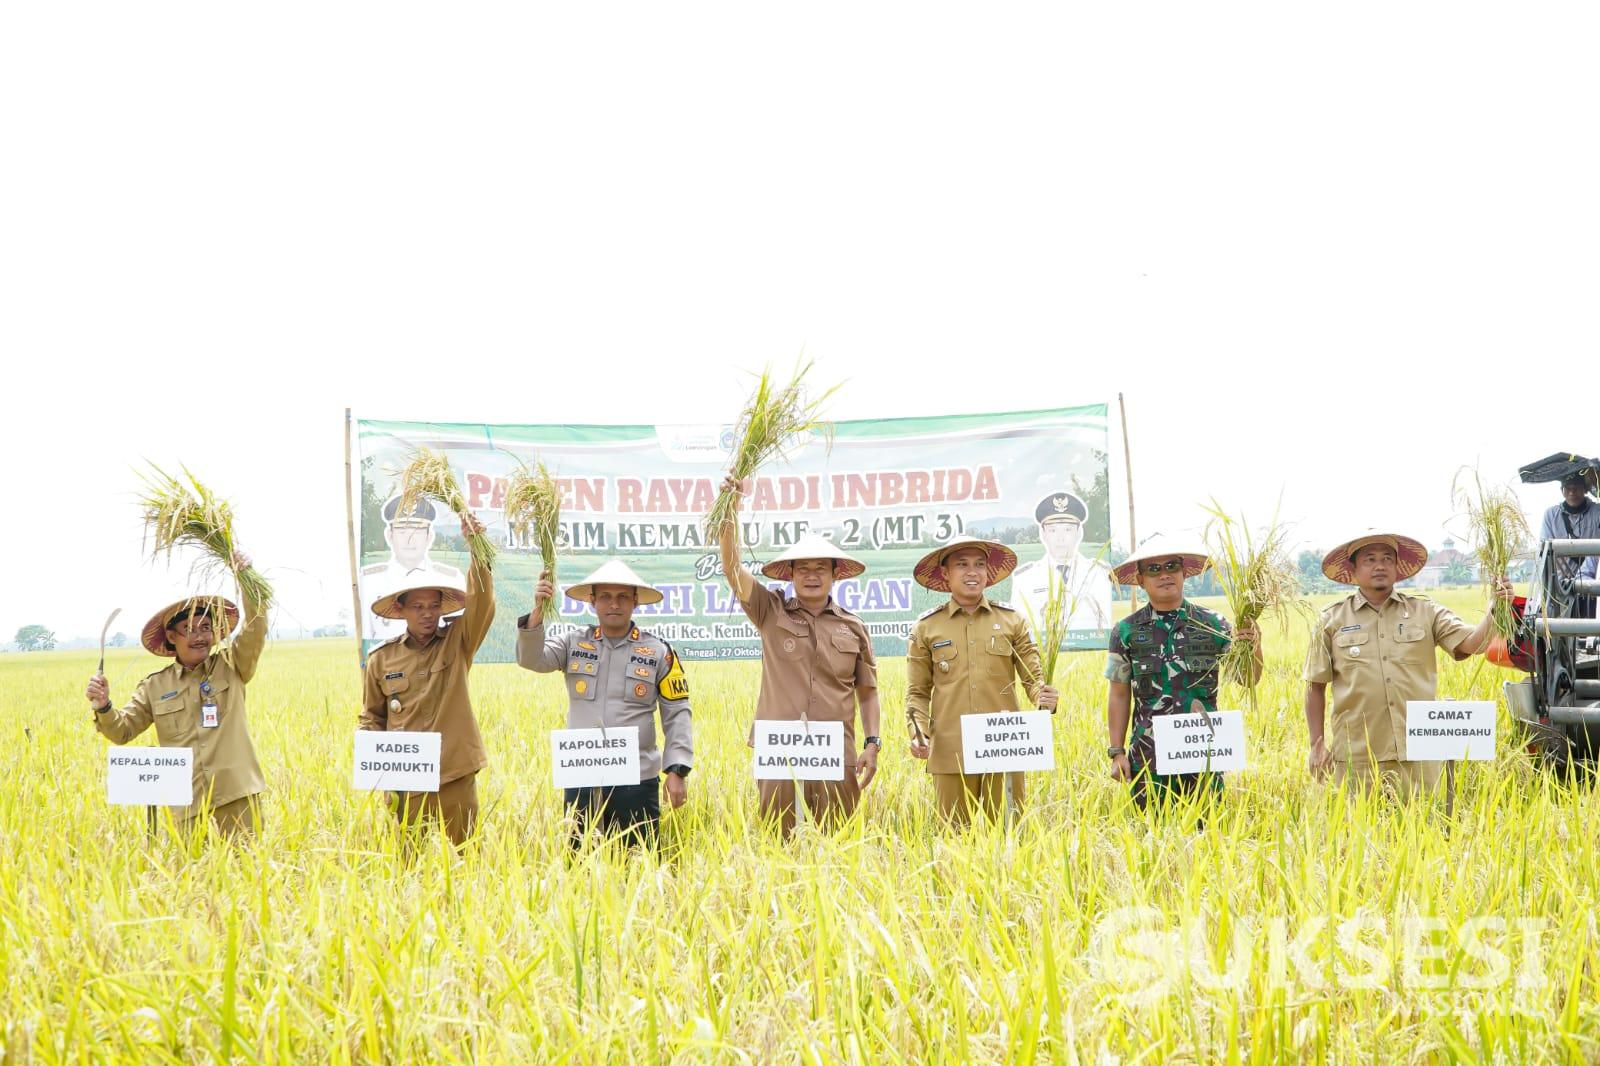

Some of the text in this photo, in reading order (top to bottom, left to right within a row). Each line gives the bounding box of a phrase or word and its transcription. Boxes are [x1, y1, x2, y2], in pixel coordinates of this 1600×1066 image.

[467, 473, 605, 511] PAEN
[617, 478, 718, 512] RAYA
[832, 466, 999, 508] INBRIDA
[844, 518, 861, 544] 2
[872, 516, 924, 548] (MT
[937, 513, 964, 540] 3)
[681, 625, 709, 638] Kec.
[684, 648, 719, 658] Tanggal,
[721, 648, 732, 657] 27
[630, 656, 658, 667] POLRI
[986, 716, 1027, 727] WAKIL
[1427, 710, 1473, 721] CAMAT
[1173, 717, 1223, 729] DANDM
[984, 731, 1031, 743] BUPATI
[1184, 733, 1215, 744] 0812
[1408, 728, 1492, 738] KEMBANGBAHU
[559, 738, 627, 751] KAPOLRES
[767, 733, 832, 747] BUPATI
[375, 743, 420, 754] KADES
[974, 745, 1045, 760] LAMONGAN
[1167, 747, 1233, 760] LAMONGAN
[110, 757, 187, 767] KEPALA DINAS
[360, 760, 434, 774] SIDOMUKTI
[560, 756, 627, 768] LAMONGAN
[758, 755, 841, 768] LAMONGAN
[138, 774, 160, 782] KPP
